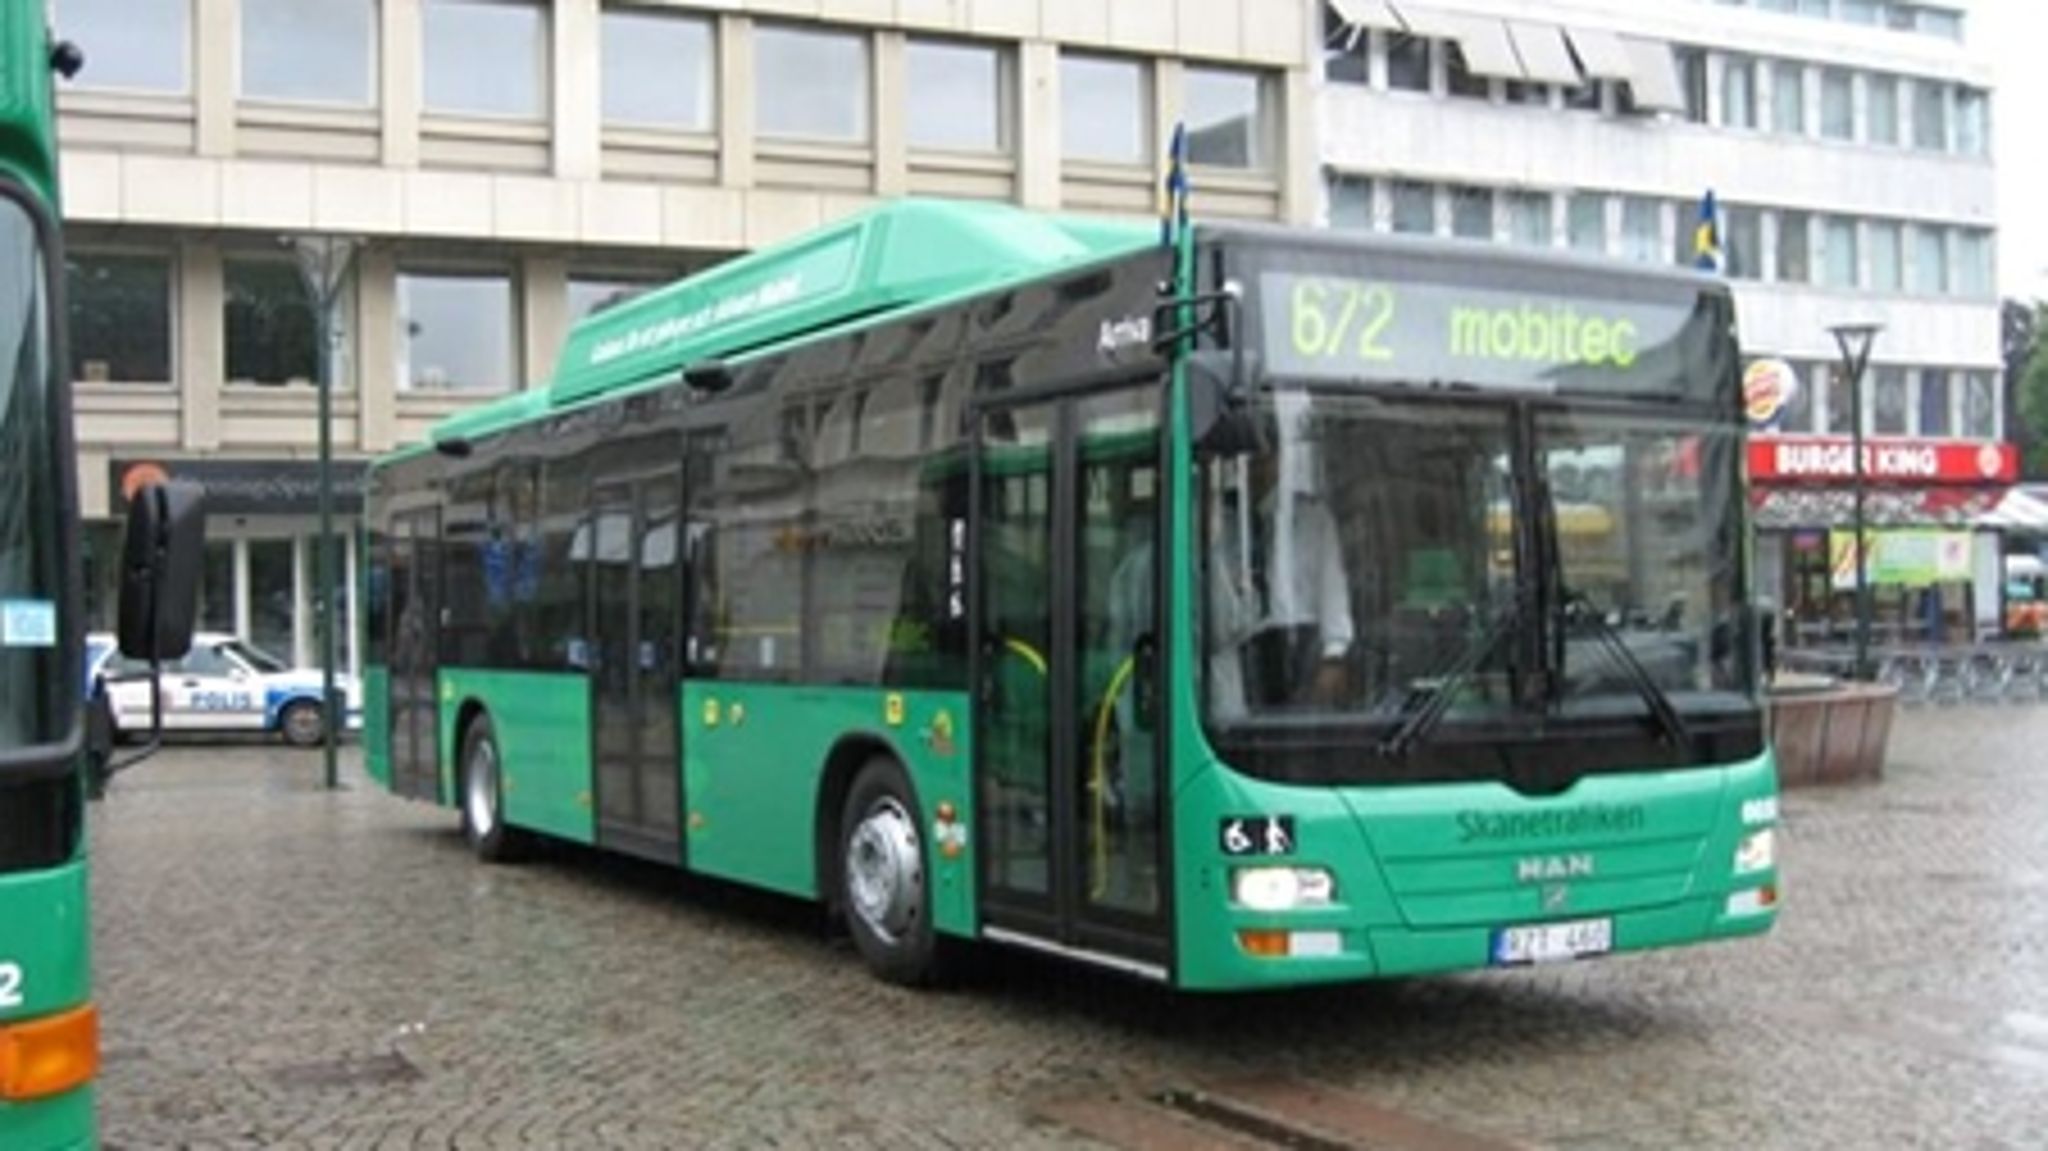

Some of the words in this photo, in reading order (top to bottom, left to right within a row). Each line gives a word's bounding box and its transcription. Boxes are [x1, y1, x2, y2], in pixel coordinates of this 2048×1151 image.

[1291, 279, 1393, 358] 672
[1451, 303, 1637, 368] mobitec
[1878, 445, 1937, 476] KING
[191, 689, 251, 711] POLIS
[1518, 854, 1593, 880] MAN
